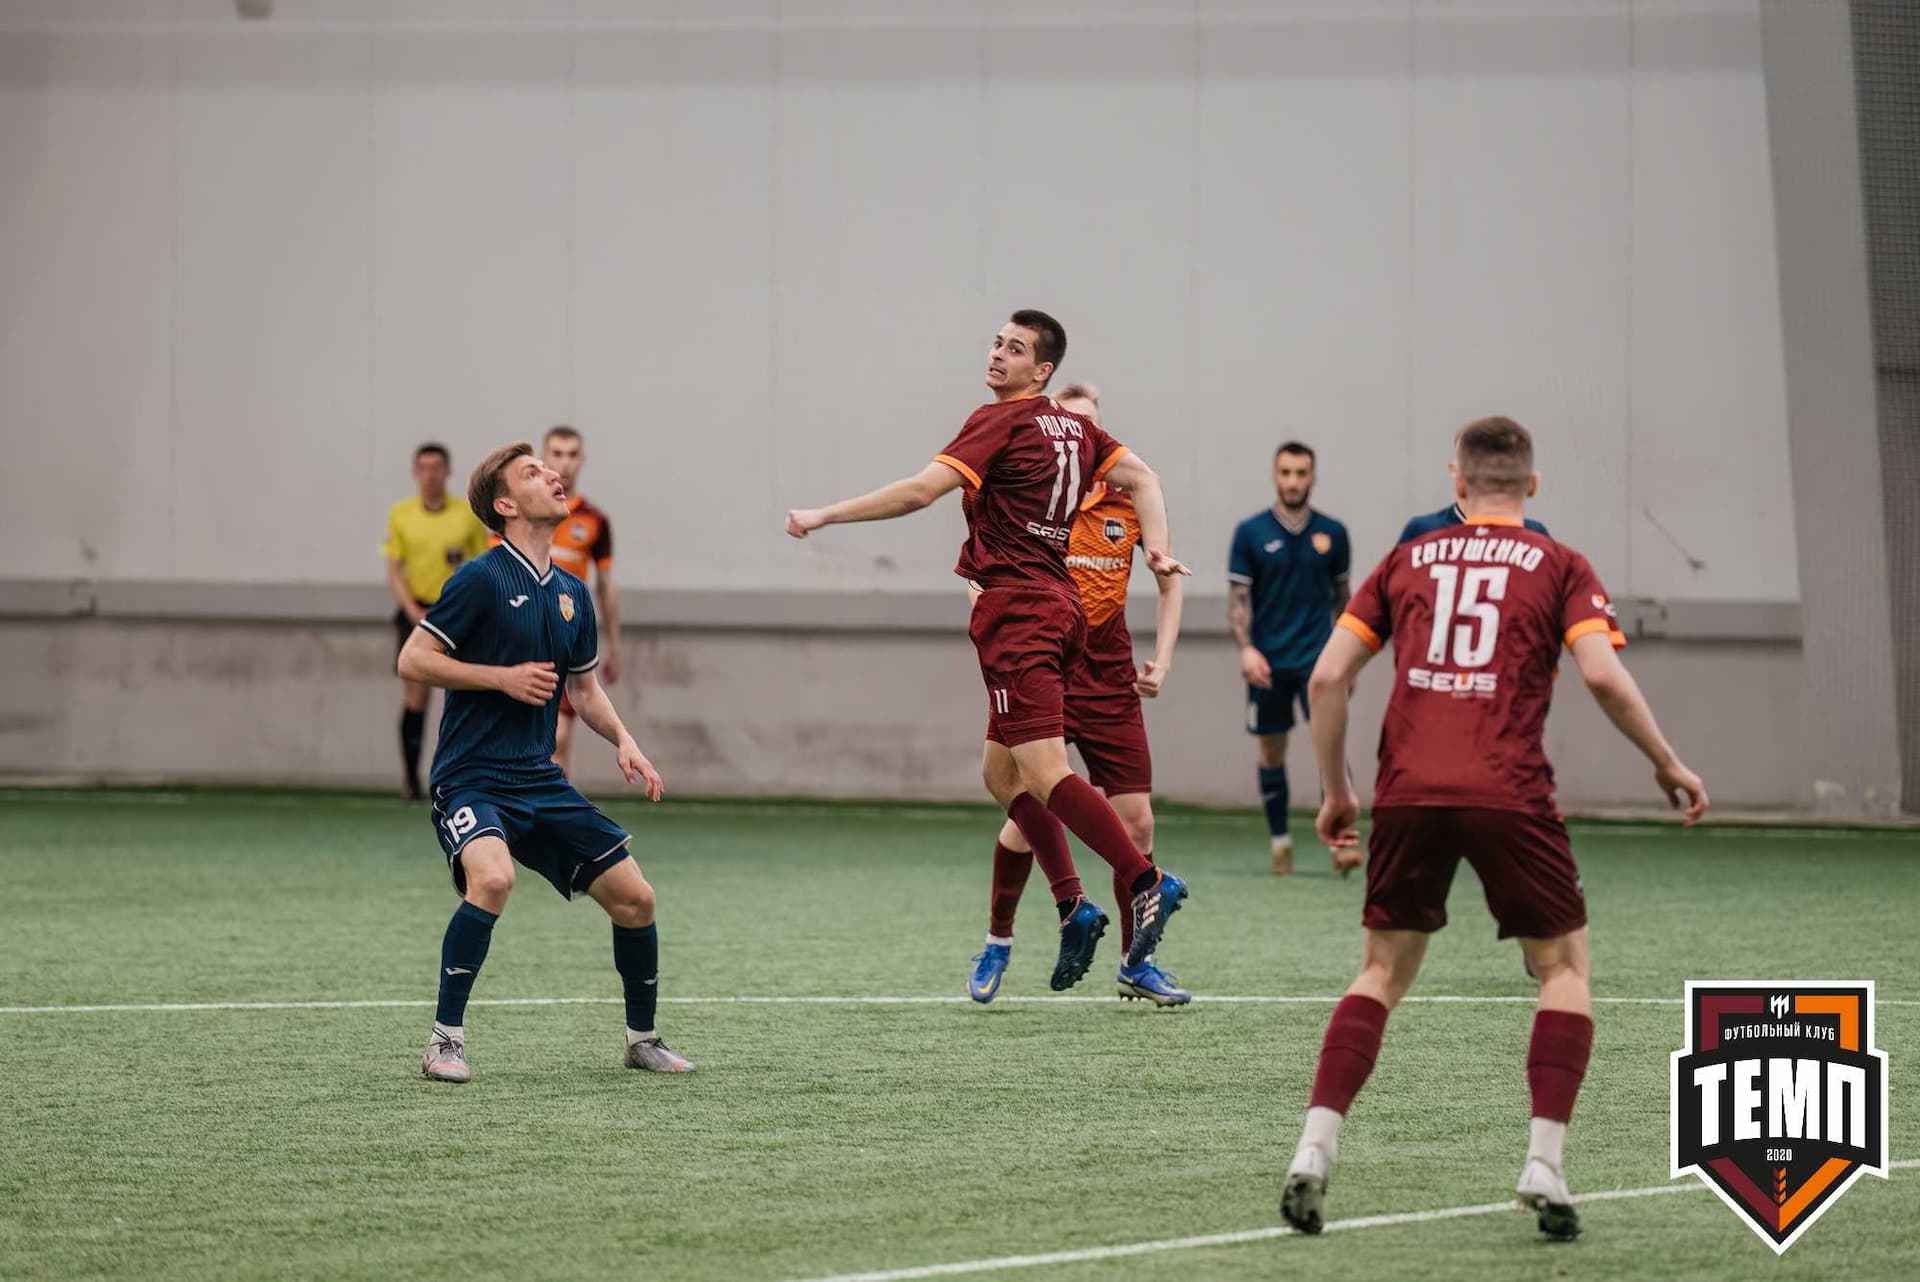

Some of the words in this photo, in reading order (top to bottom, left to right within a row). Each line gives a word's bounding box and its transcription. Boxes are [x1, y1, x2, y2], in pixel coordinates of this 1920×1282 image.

[1047, 440, 1080, 521] 11
[1426, 564, 1509, 668] 15
[1407, 667, 1498, 692] SEUS
[994, 688, 1010, 714] 11
[446, 806, 478, 844] 19
